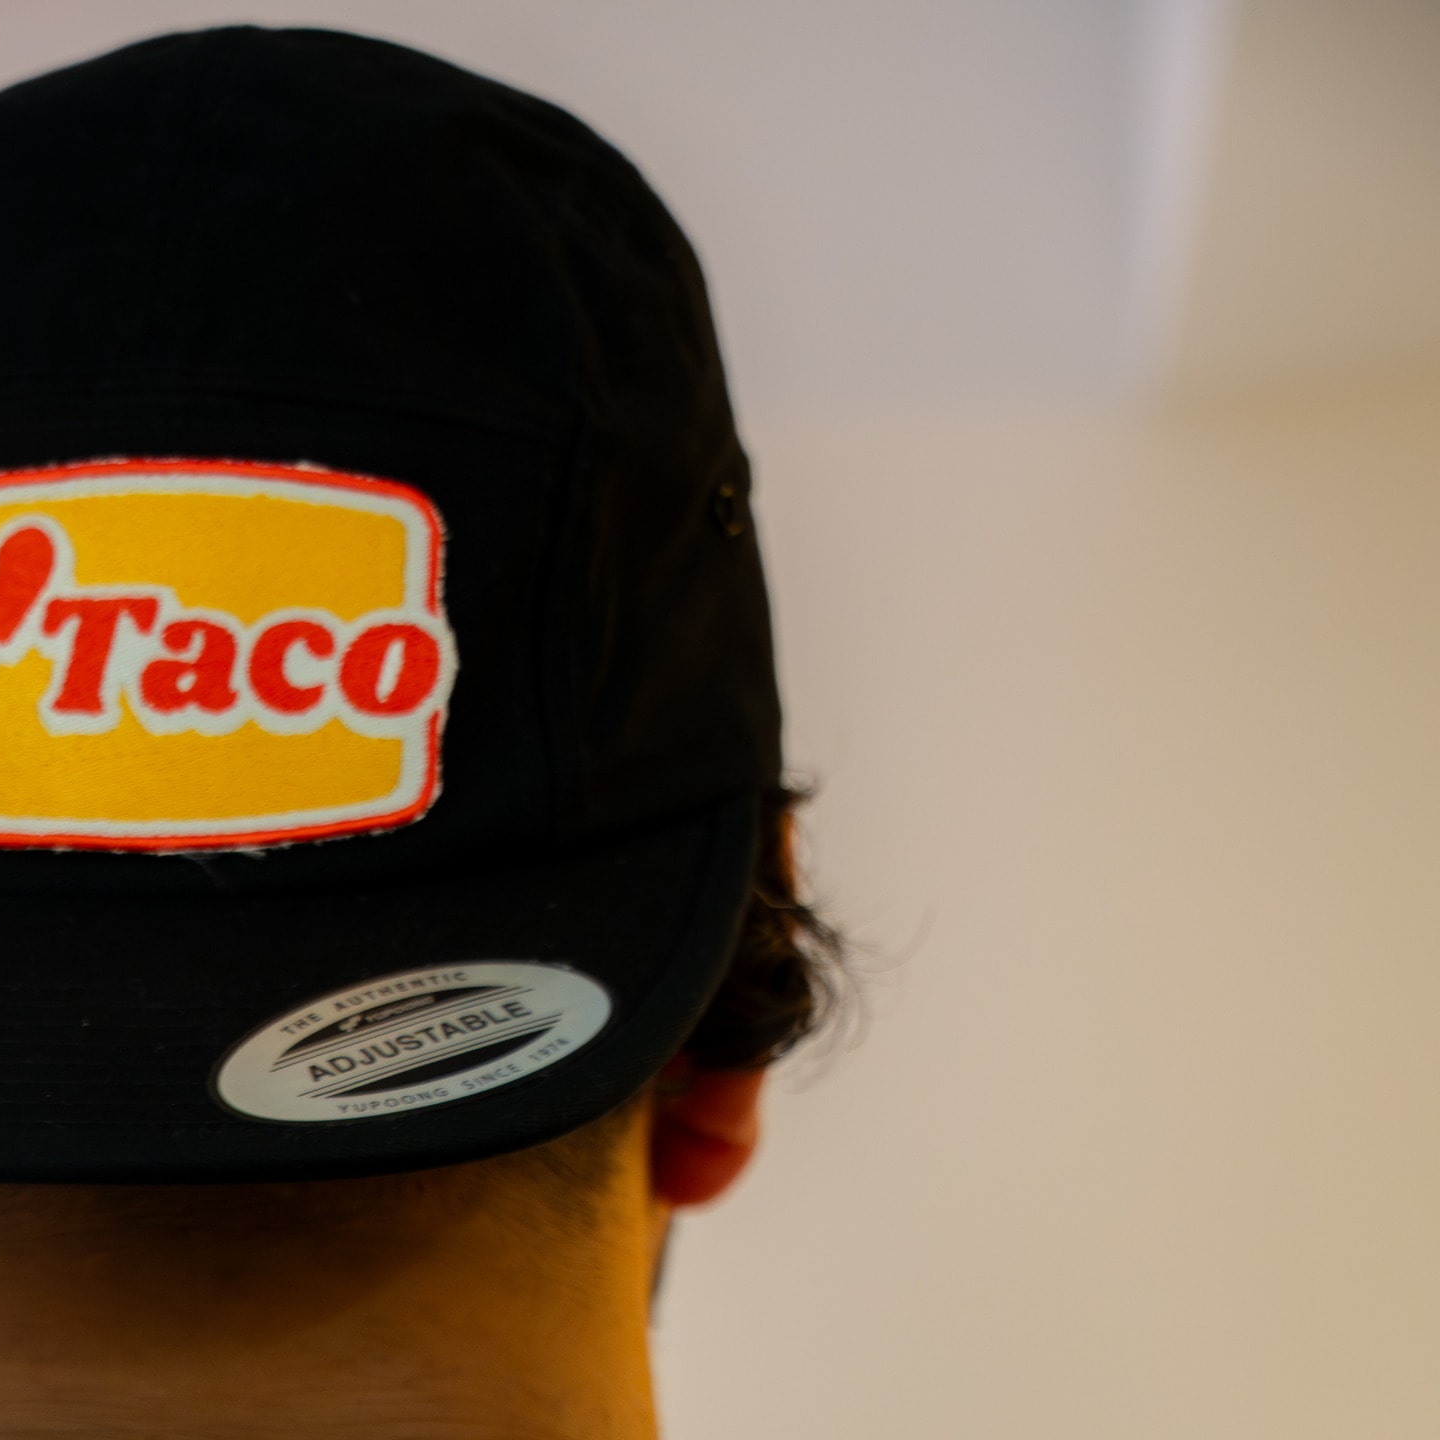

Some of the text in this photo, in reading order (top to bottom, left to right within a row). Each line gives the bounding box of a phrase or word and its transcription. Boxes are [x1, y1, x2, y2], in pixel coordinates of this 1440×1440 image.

[280, 1012, 323, 1036] THE
[333, 971, 470, 1013] AUTHENTIC
[307, 1000, 533, 1083] ADJUSTABLE
[337, 1086, 450, 1114] YUPOONG
[460, 1063, 523, 1091] SINCE
